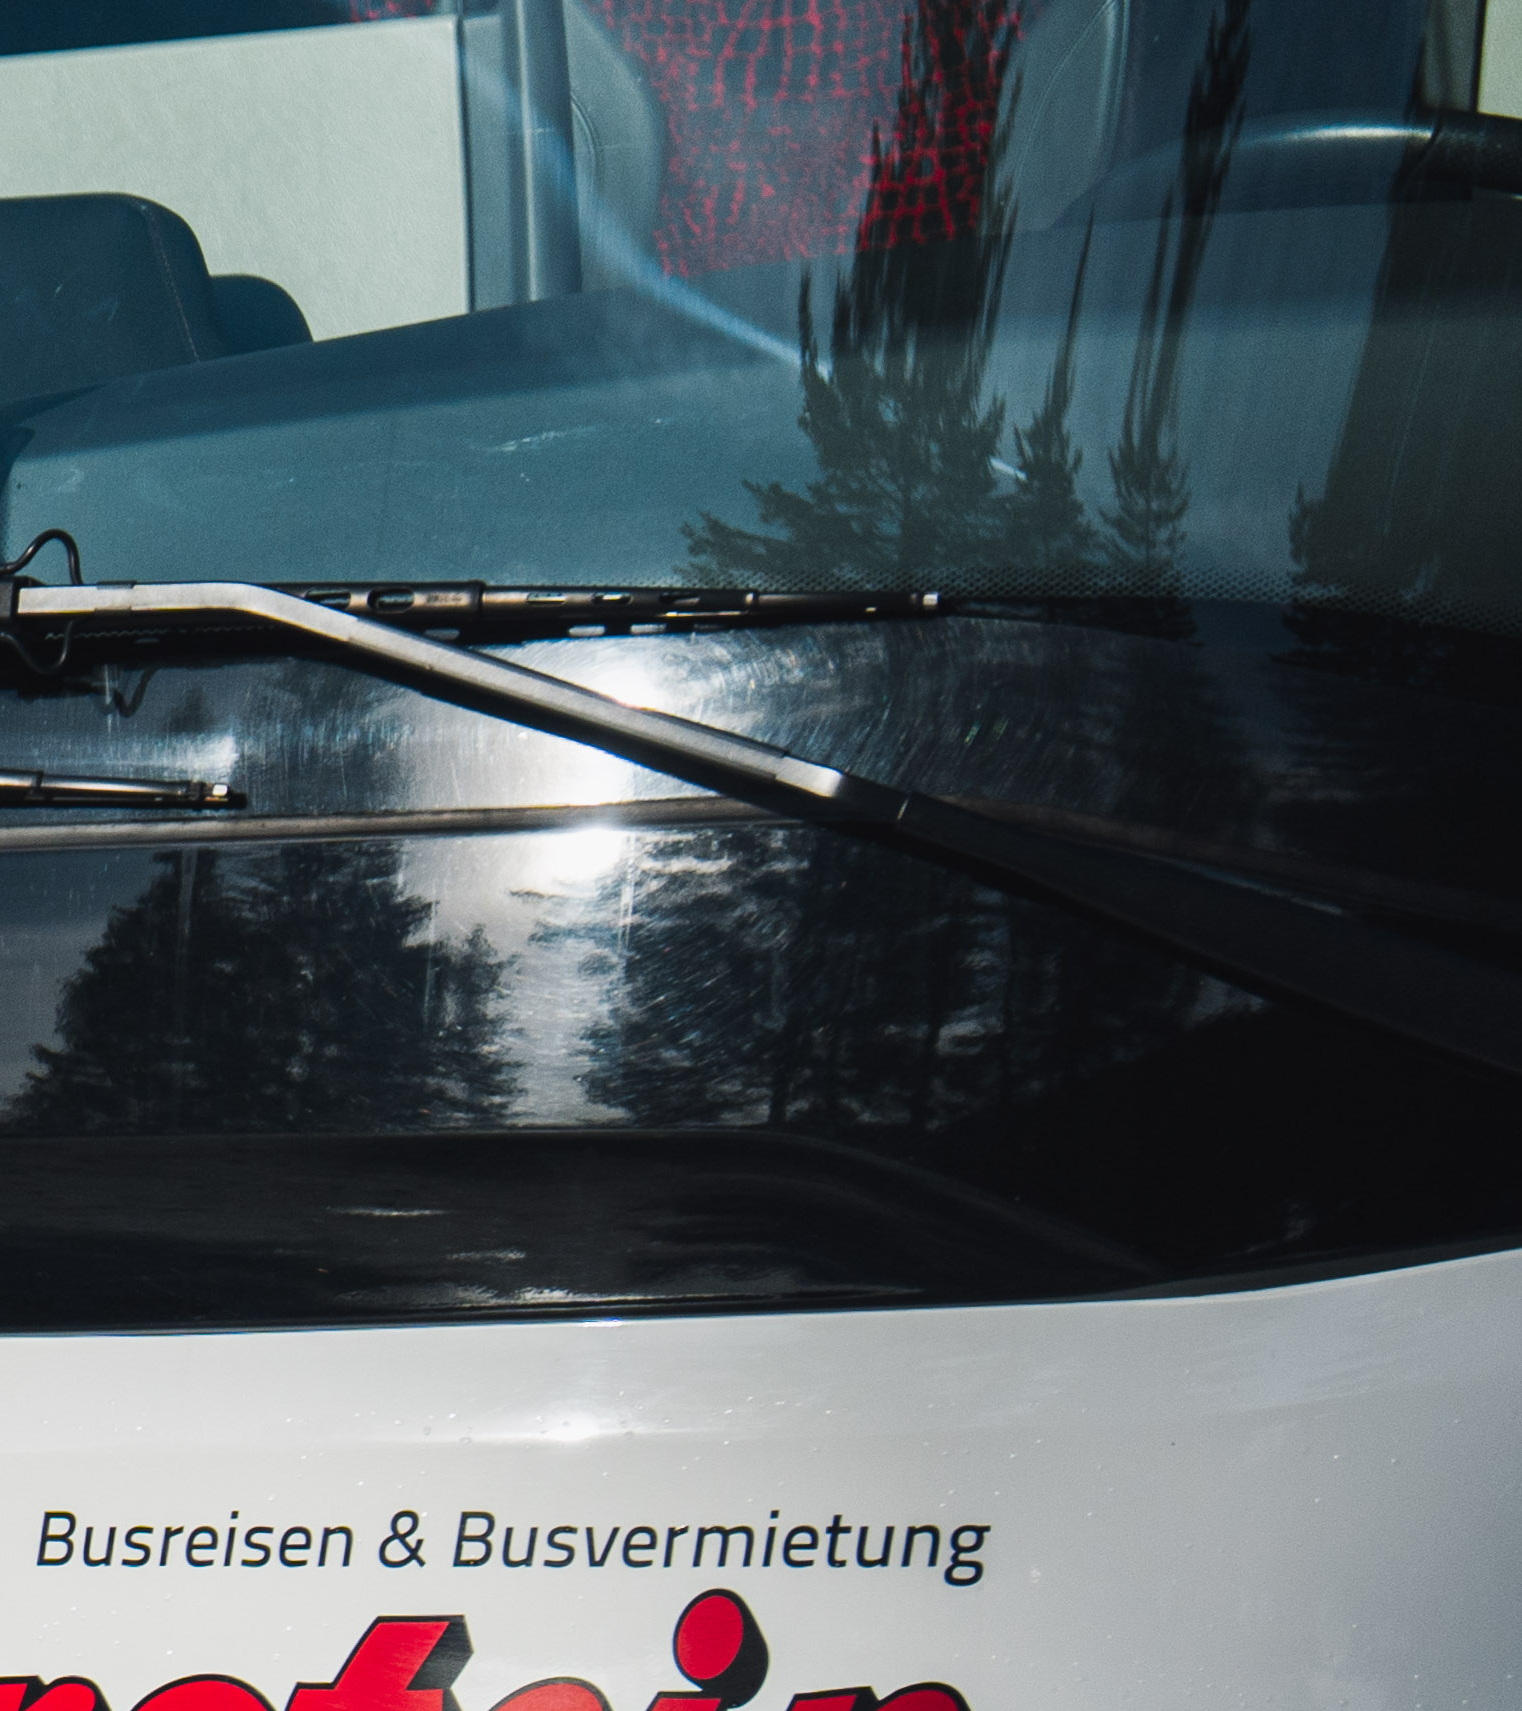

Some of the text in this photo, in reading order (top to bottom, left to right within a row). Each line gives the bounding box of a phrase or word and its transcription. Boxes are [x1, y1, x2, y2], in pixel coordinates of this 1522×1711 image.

[35, 1511, 991, 1587] Busreisen & Busvermietung
